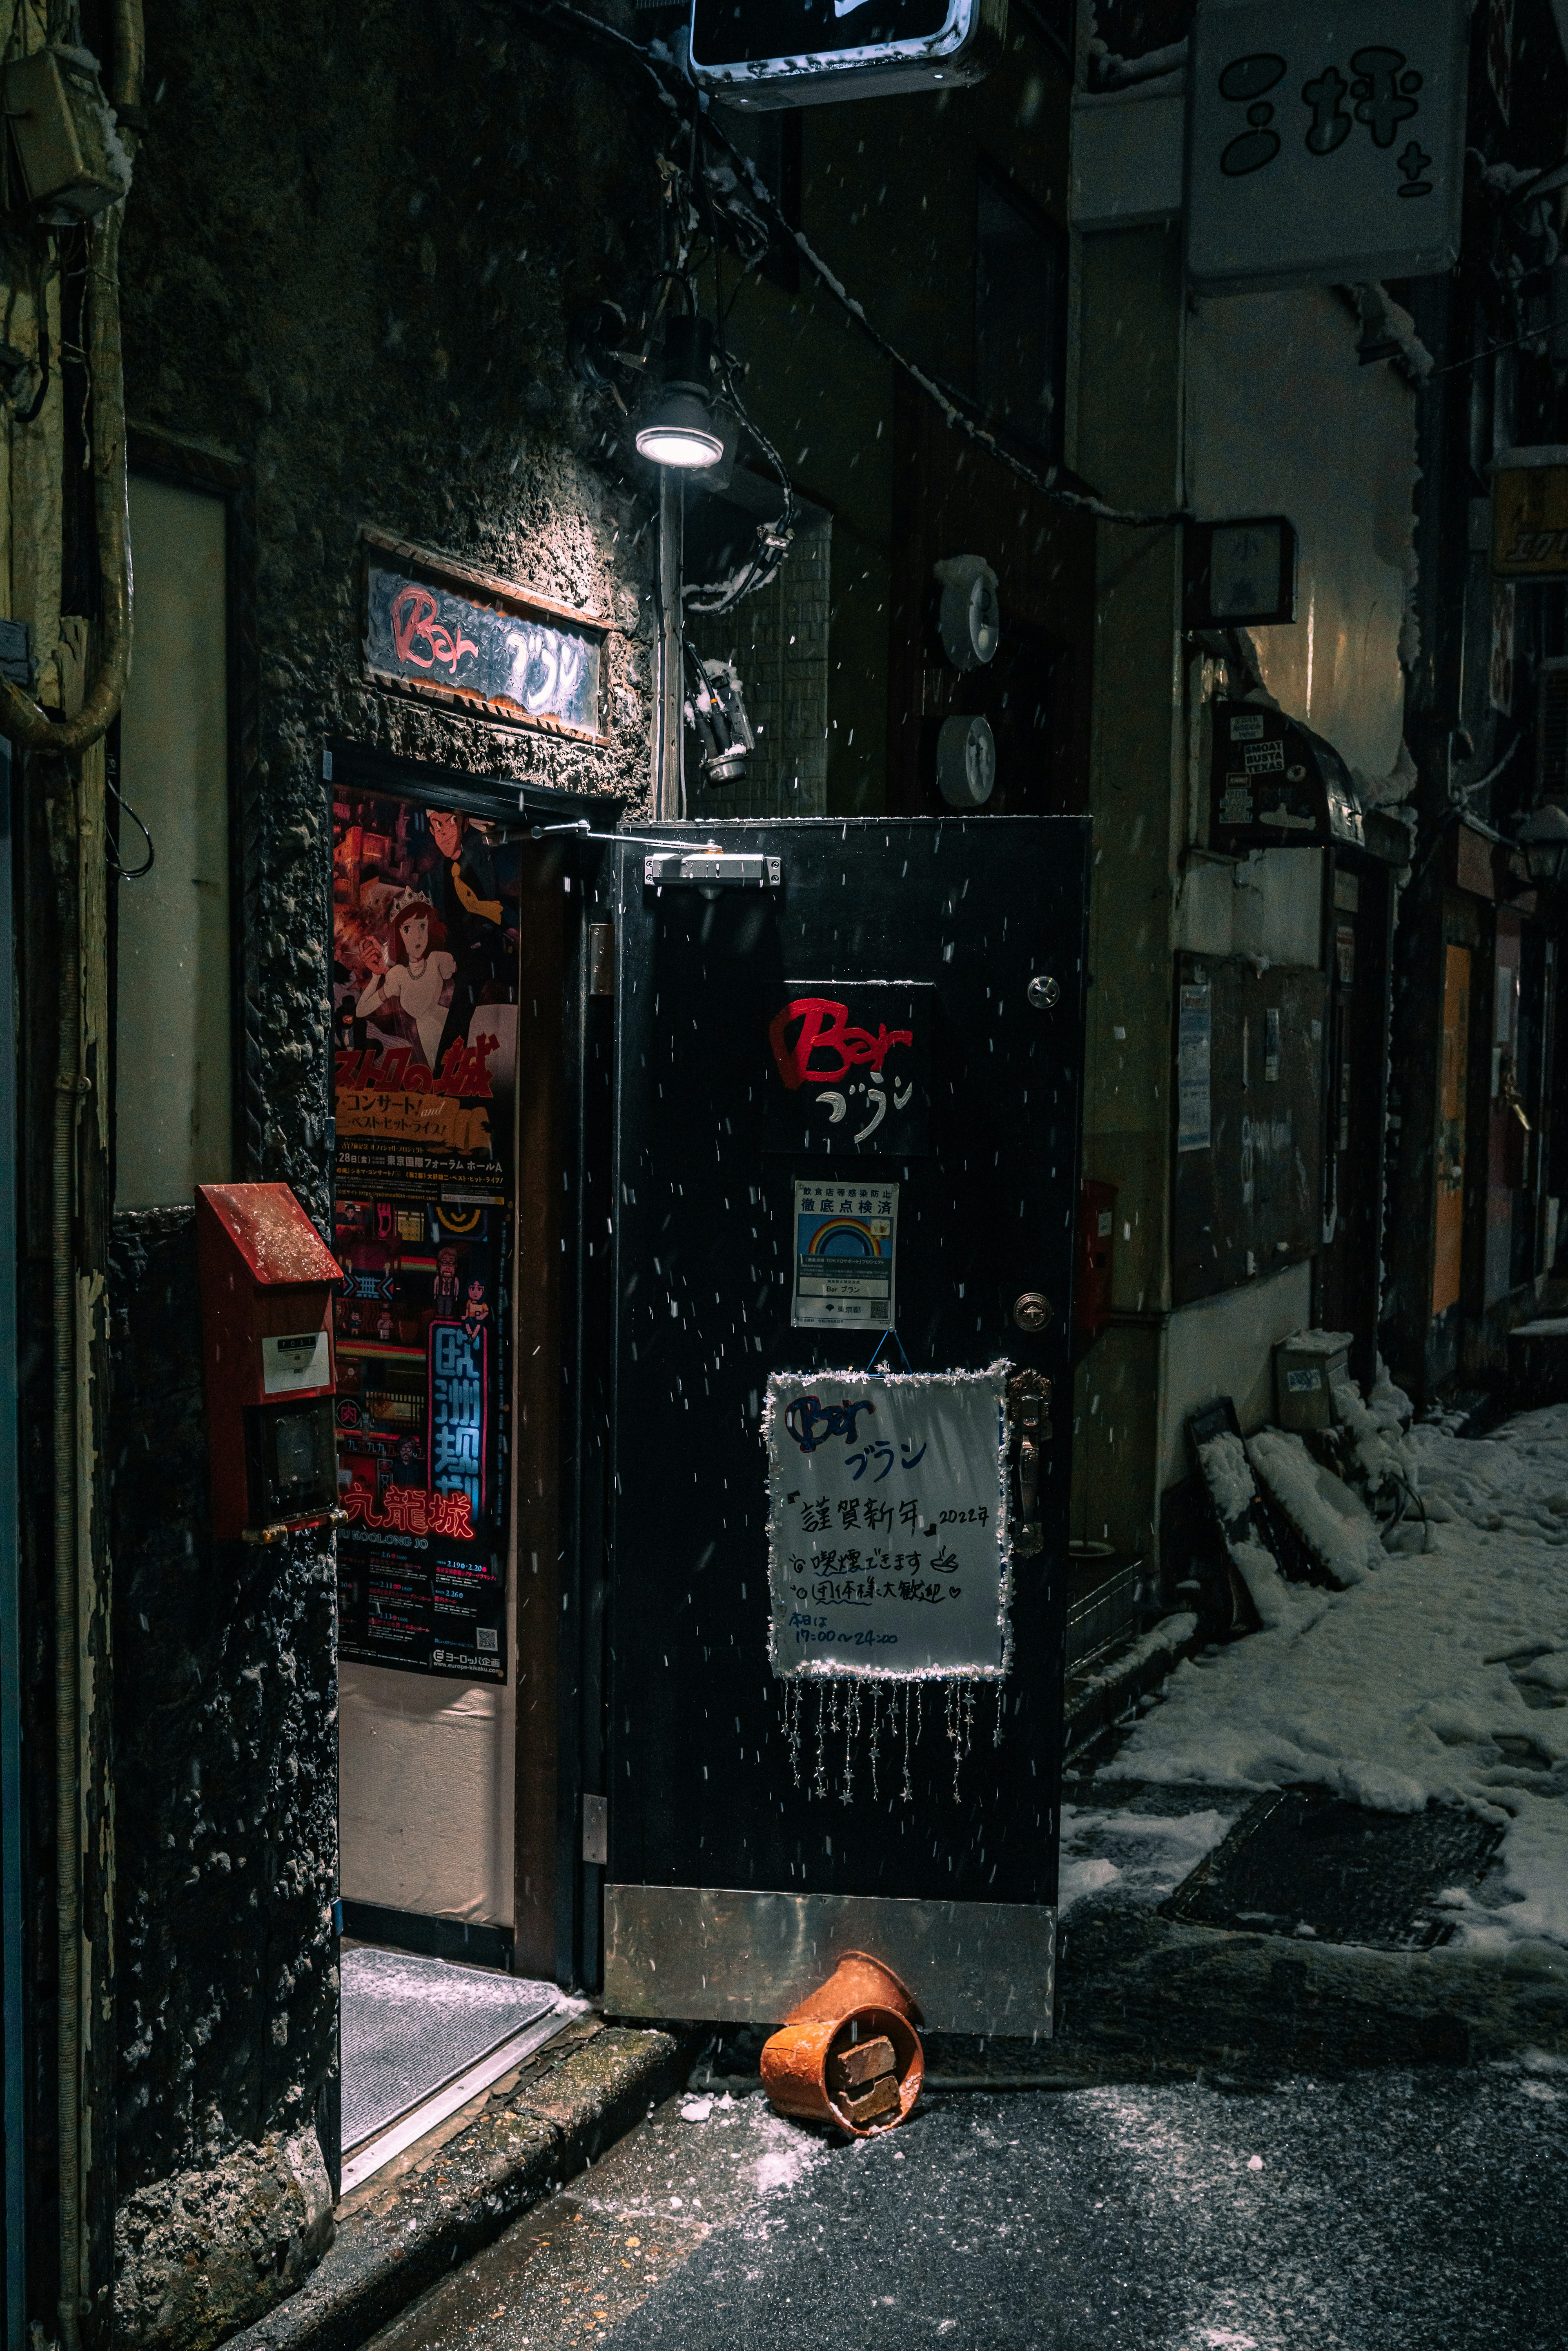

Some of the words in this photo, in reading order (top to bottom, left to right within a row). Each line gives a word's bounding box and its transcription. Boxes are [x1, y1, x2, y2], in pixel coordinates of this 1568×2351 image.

[392, 586, 479, 674] Bar
[769, 998, 913, 1090] Bar
[421, 1101, 445, 1117] and
[388, 1155, 464, 1169] 東京国際フォーラム
[467, 1161, 502, 1172] ホールA
[803, 1187, 891, 1198] 飲食店等感染防止
[801, 1198, 892, 1214] 徹底点検済
[340, 1404, 357, 1424] 肉
[785, 1395, 875, 1453] Bar
[845, 1440, 927, 1483] ブラン
[352, 1530, 412, 1547] KOOLONG
[789, 1612, 827, 1628] 本日は
[445, 1652, 500, 1668] ヨーロッパ企画
